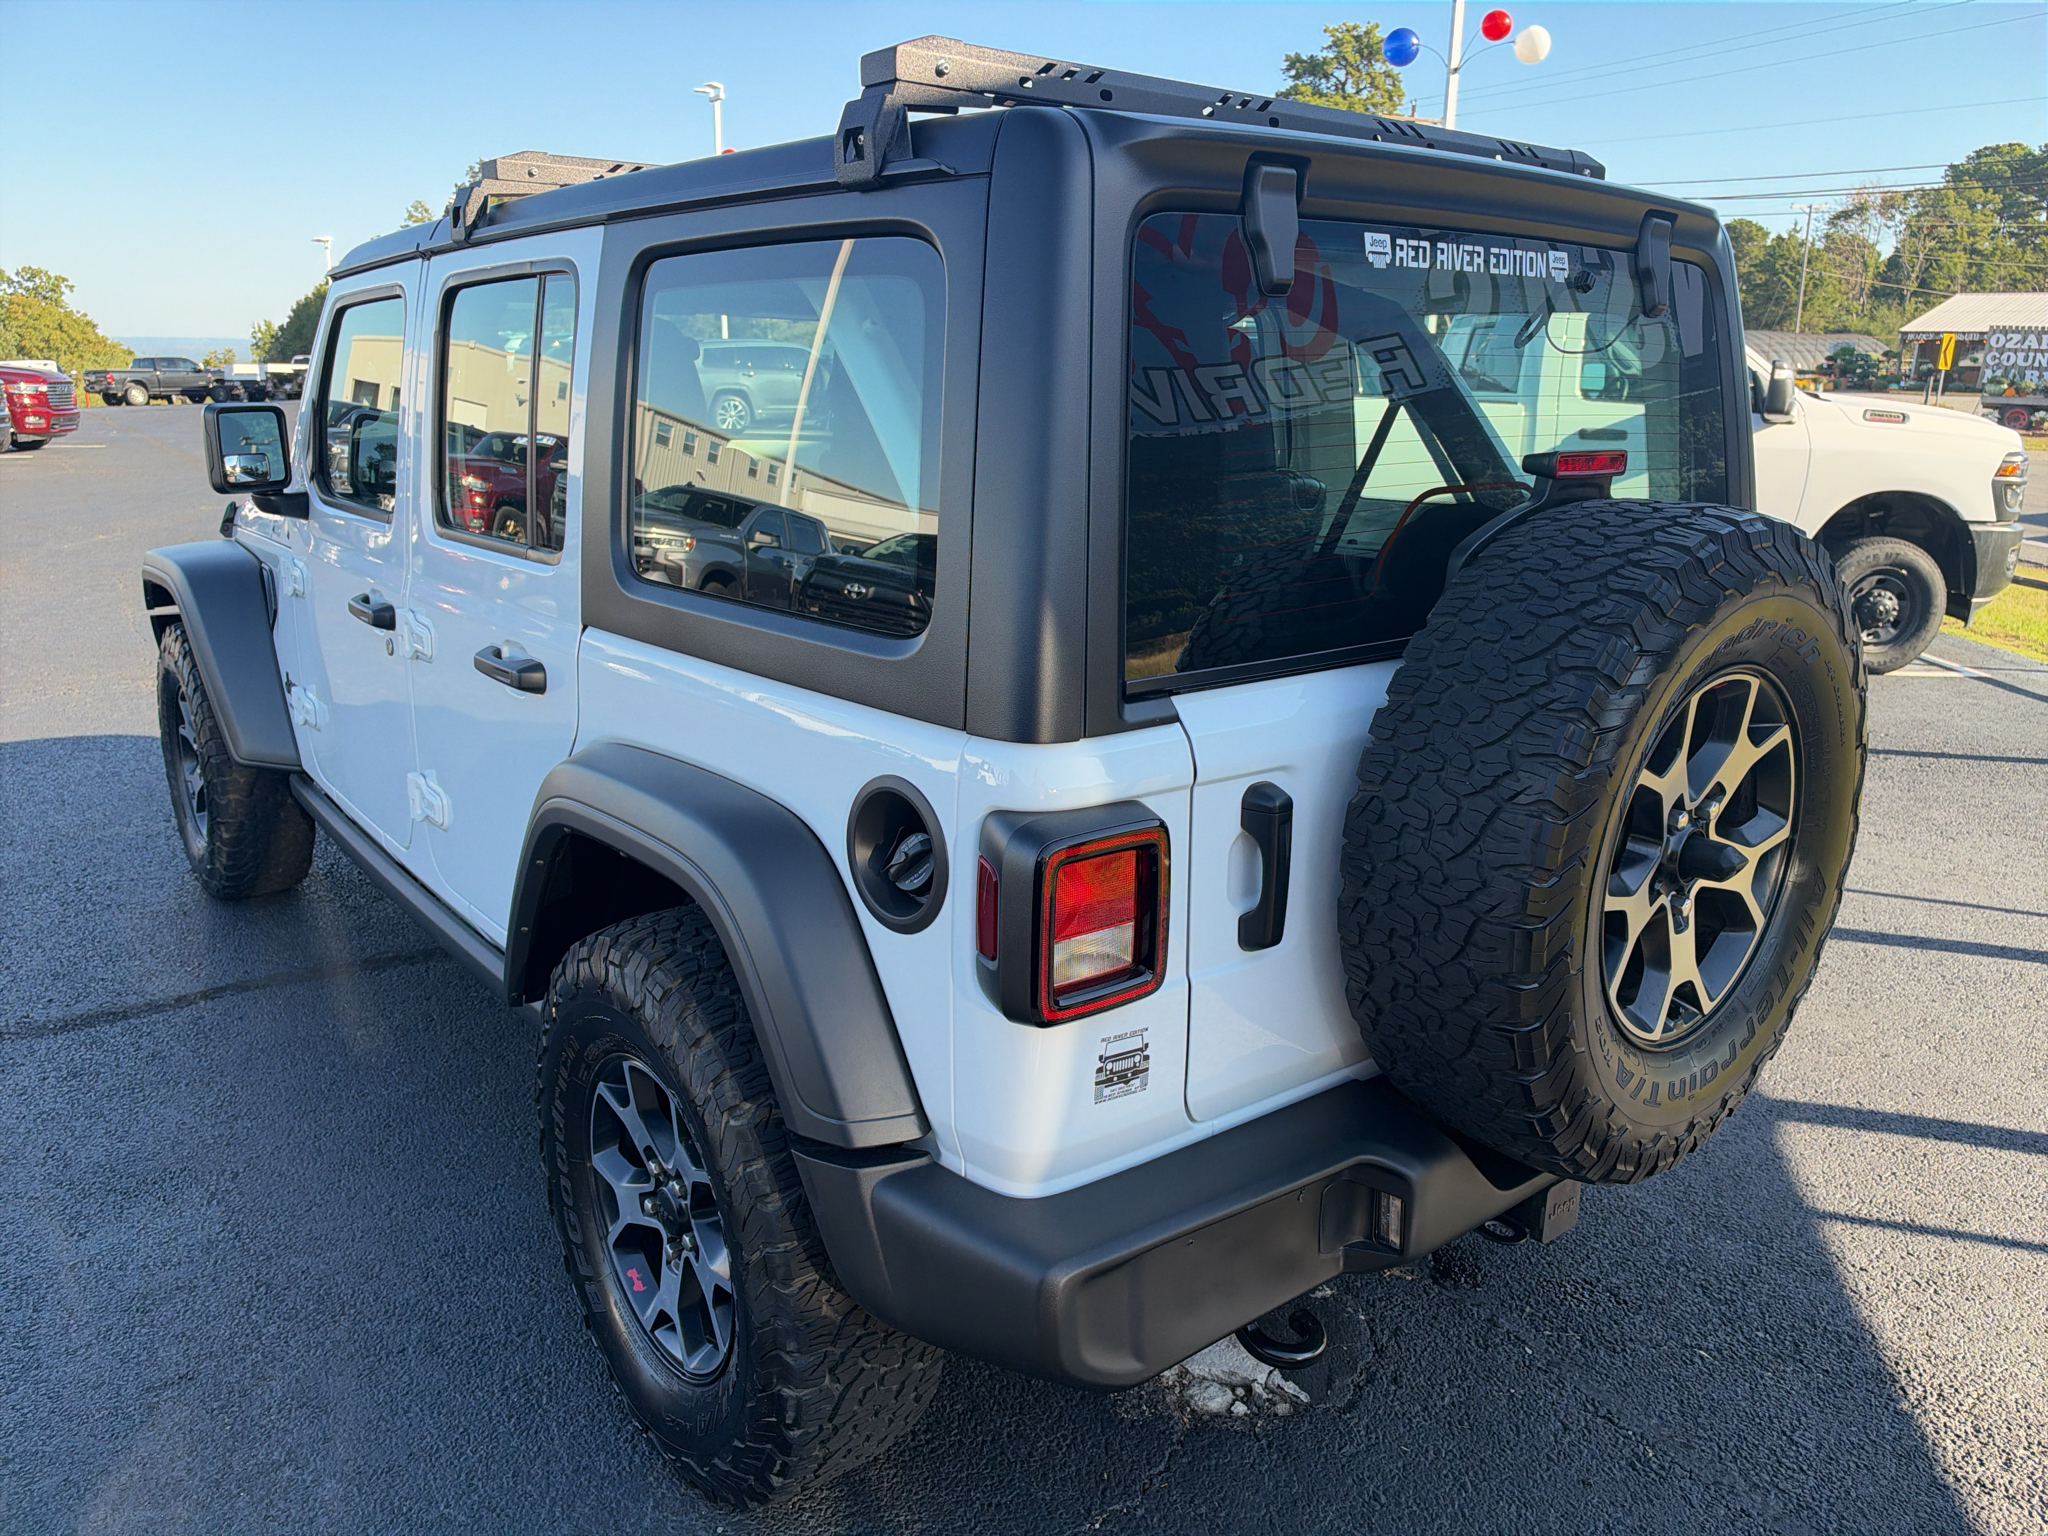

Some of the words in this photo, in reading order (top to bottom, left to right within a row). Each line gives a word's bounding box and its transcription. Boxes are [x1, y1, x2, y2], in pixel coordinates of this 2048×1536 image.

[1369, 235, 1388, 250] Jeep
[1395, 238, 1431, 269] RED
[1436, 242, 1485, 273] RIVER
[1489, 247, 1547, 279] EDITION
[1551, 253, 1566, 266] Jeep
[1548, 1196, 1577, 1221] Jeep
